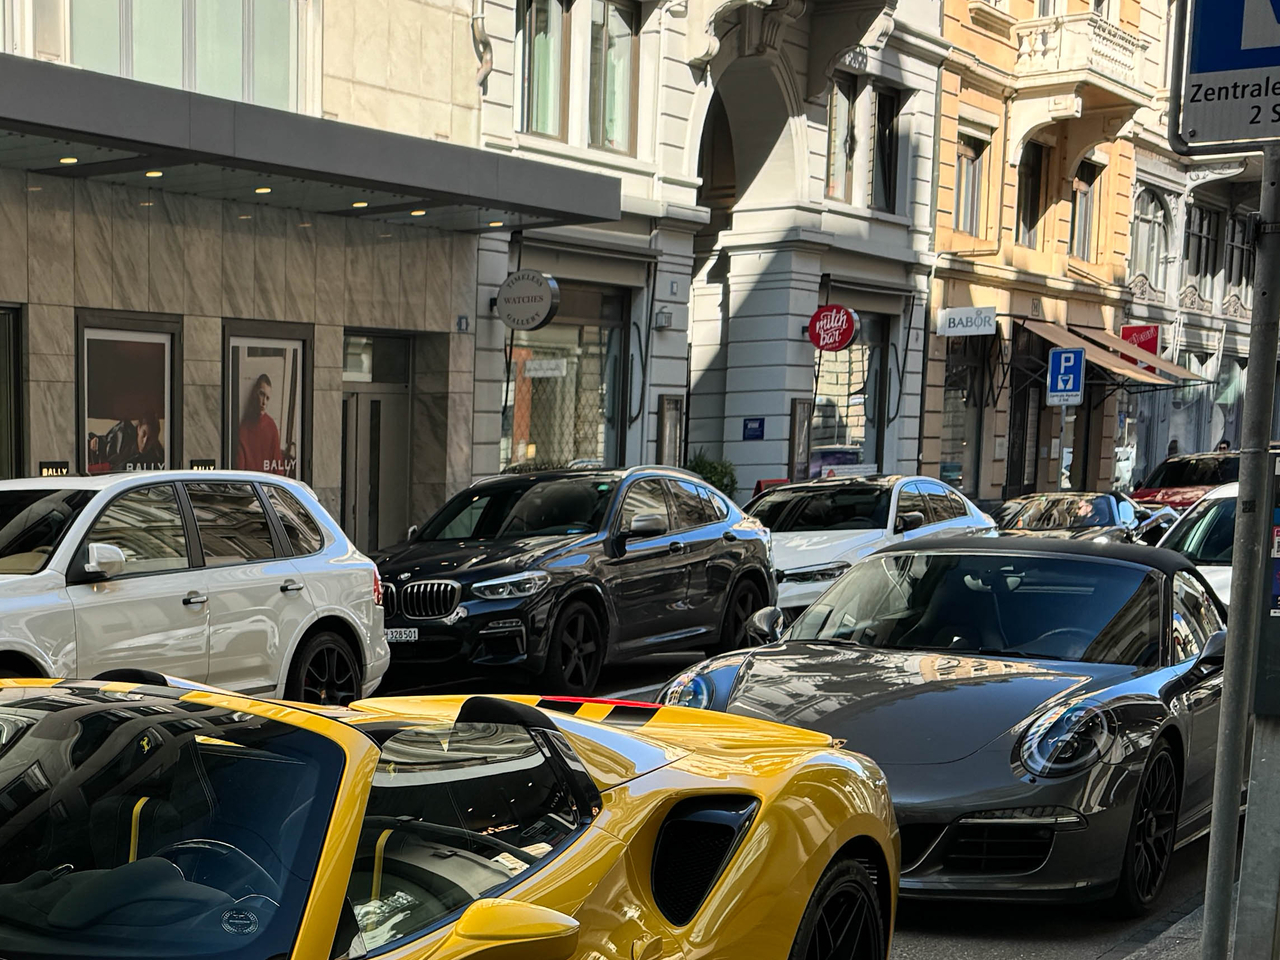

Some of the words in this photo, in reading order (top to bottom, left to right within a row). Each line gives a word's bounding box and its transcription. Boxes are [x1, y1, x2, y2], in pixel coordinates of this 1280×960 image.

[1189, 76, 1280, 103] Zentrale
[1249, 105, 1262, 124] 2
[507, 274, 542, 288] TIMELESS
[503, 295, 544, 304] WATCHES
[507, 311, 540, 325] GALLERY
[948, 311, 992, 329] BABOR
[819, 329, 841, 346] bar
[1060, 353, 1074, 374] P
[42, 467, 67, 477] BALLY
[263, 459, 297, 471] BALLY
